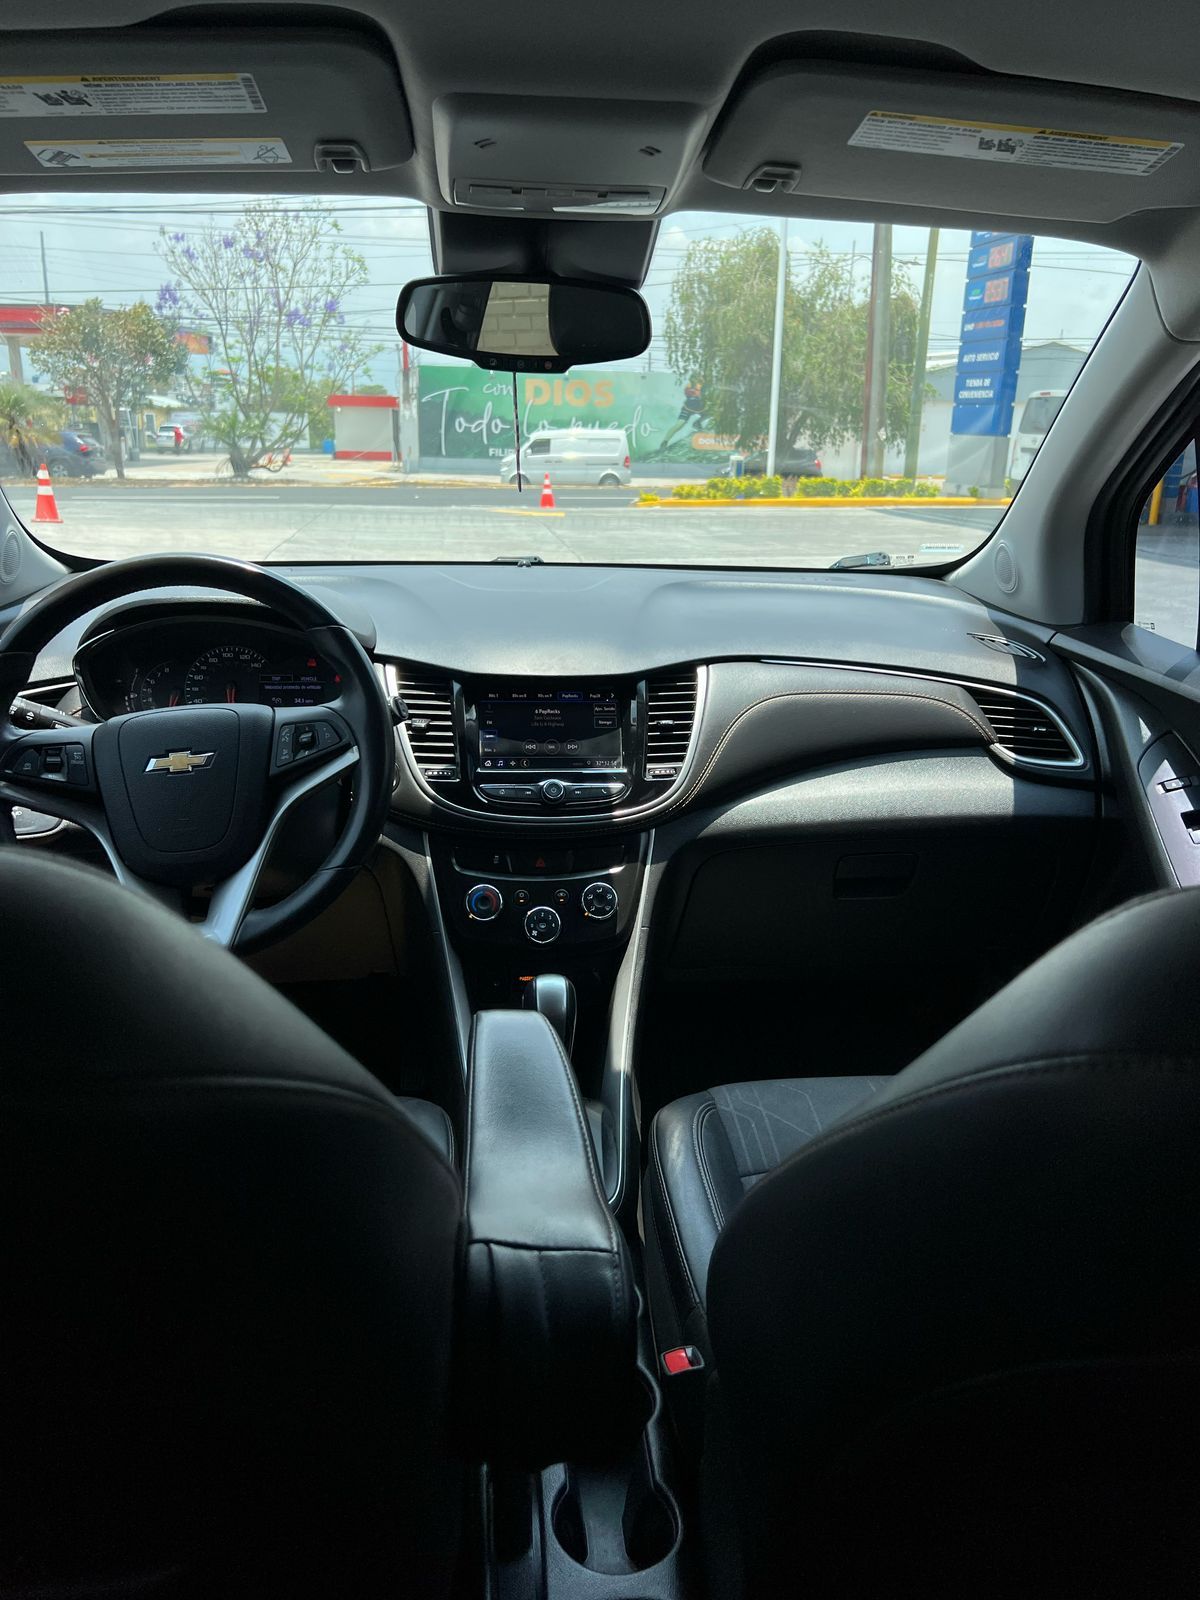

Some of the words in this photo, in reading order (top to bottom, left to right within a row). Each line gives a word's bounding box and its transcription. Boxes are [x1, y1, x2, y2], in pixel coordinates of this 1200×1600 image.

[962, 353, 976, 363] AUTO
[976, 352, 1000, 362] SERVICIO
[965, 378, 983, 387] TIENDA
[983, 378, 992, 387] DE
[483, 383, 513, 396] con
[525, 379, 615, 407] DIOS
[421, 386, 511, 456] Todo
